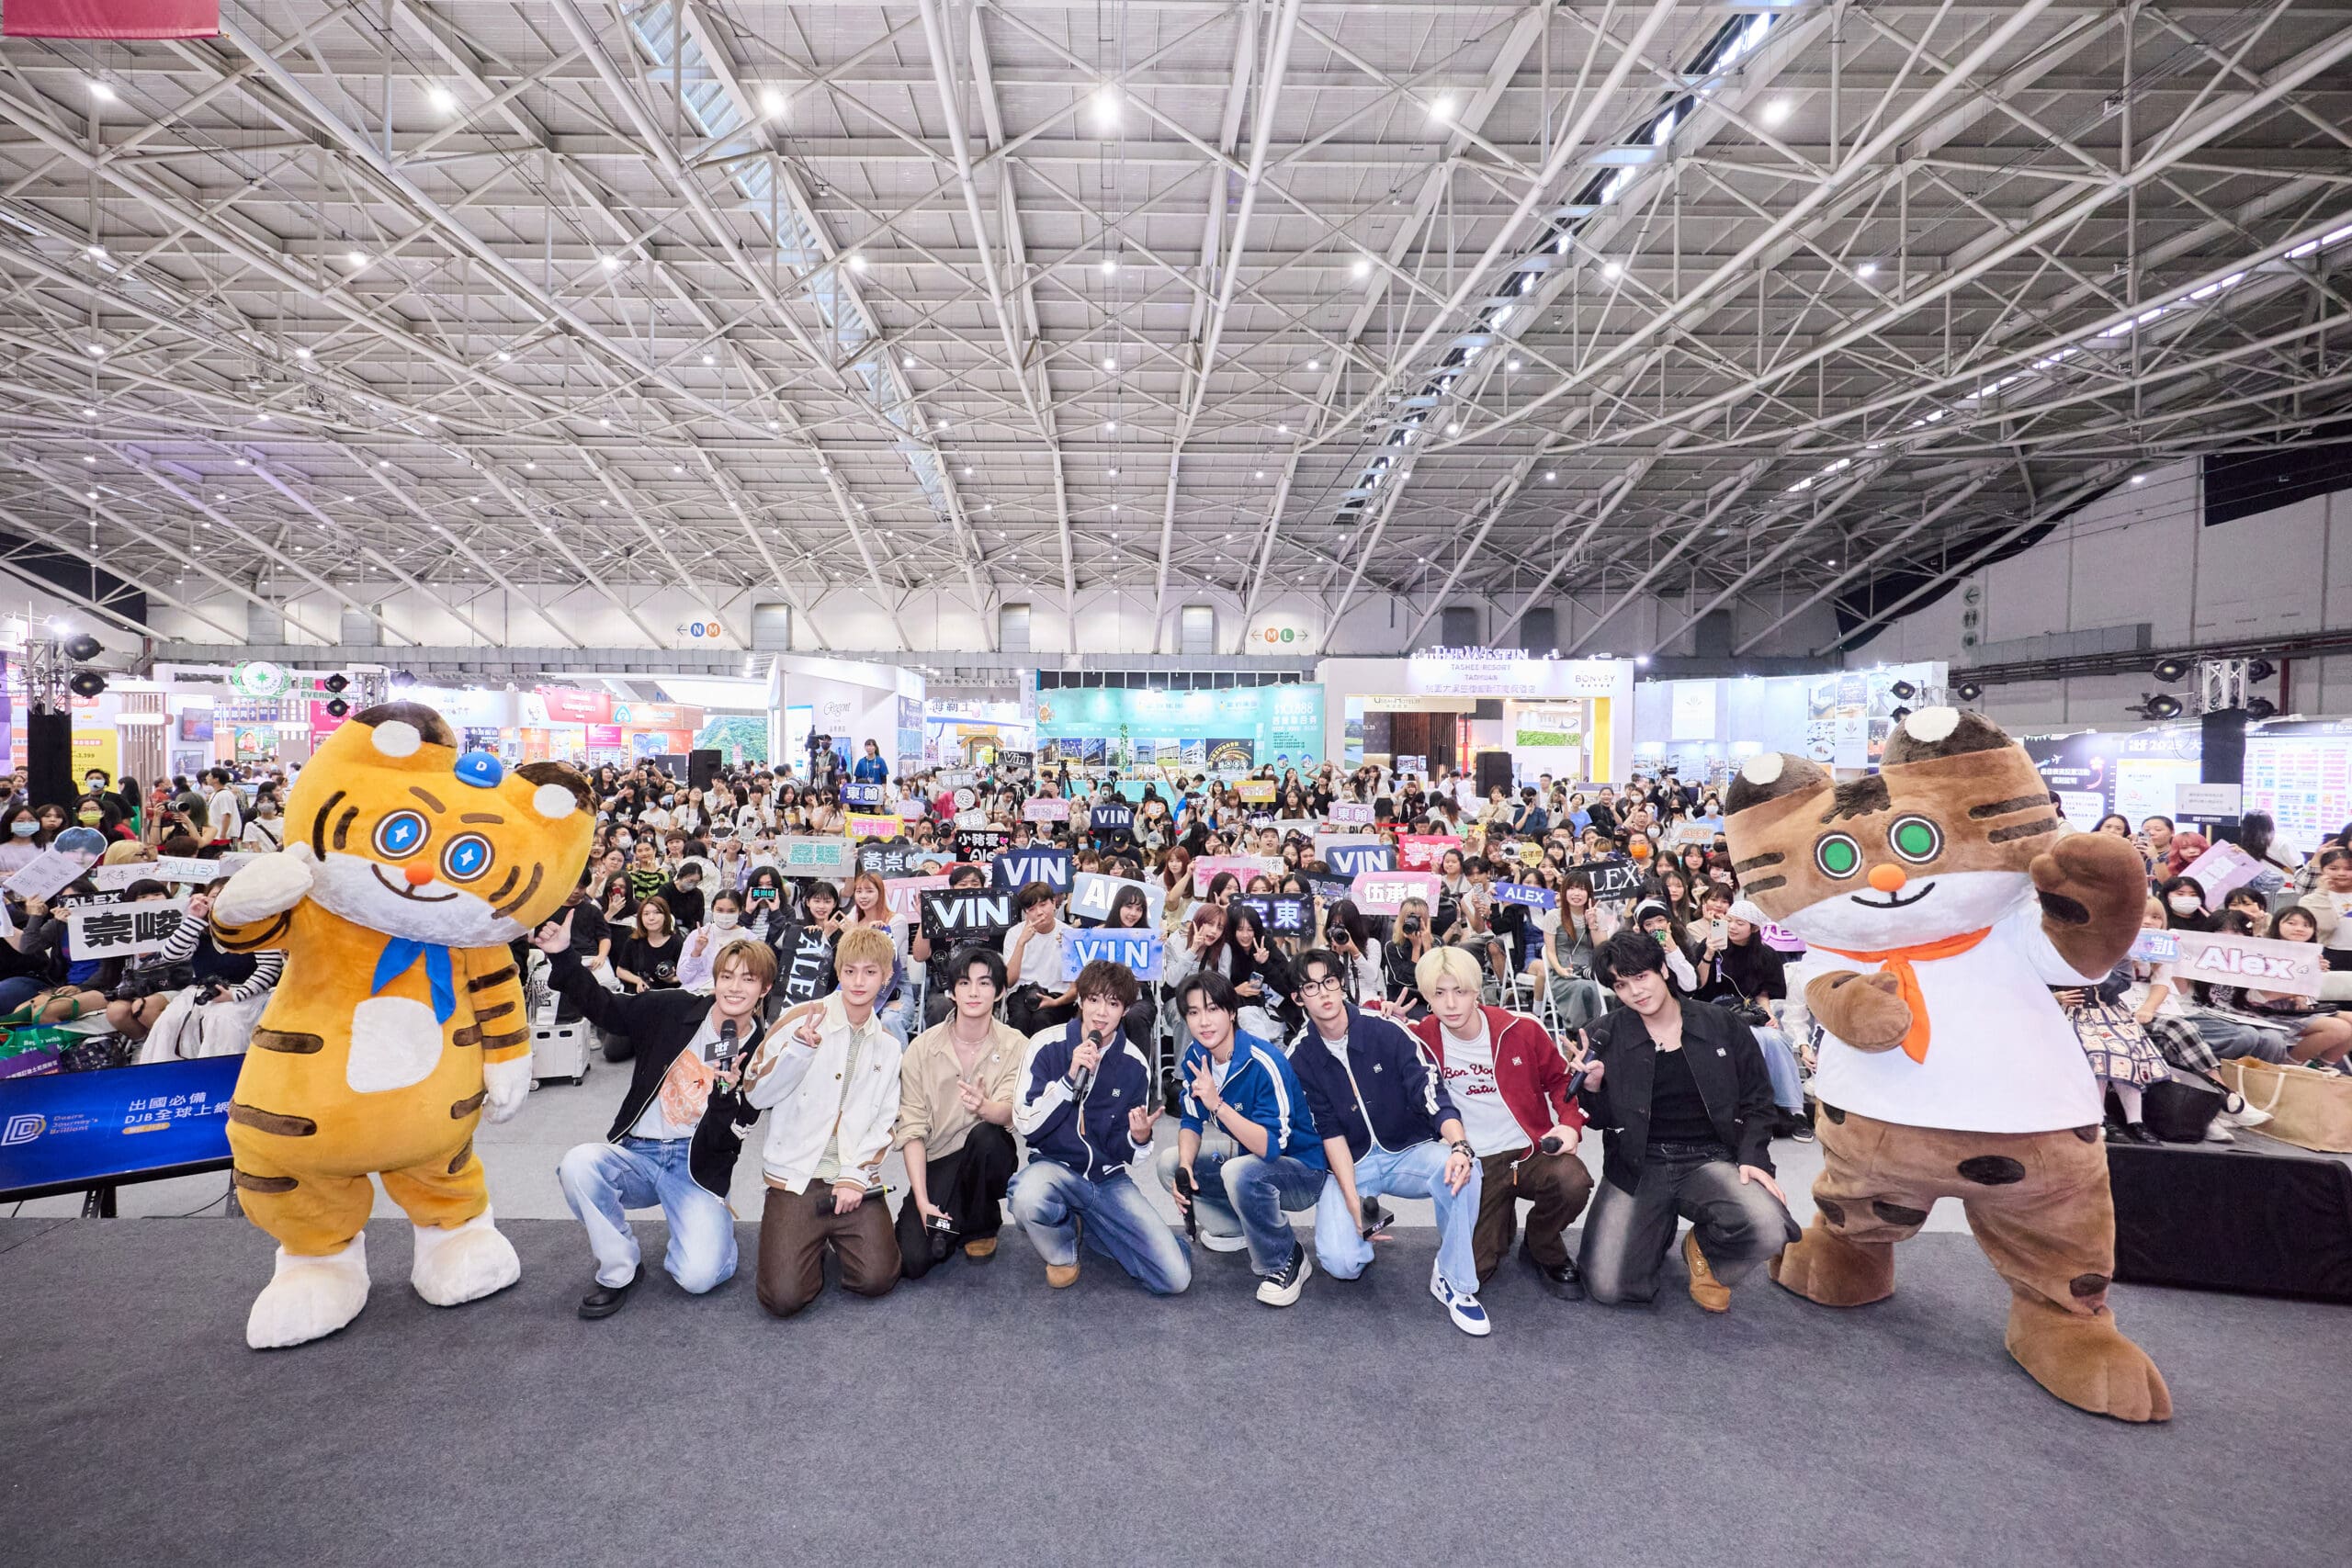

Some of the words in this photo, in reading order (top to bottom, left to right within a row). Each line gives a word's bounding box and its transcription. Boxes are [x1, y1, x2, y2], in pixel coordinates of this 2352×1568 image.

[693, 625, 703, 635] N
[707, 625, 718, 635] M
[1266, 630, 1277, 640] M
[475, 761, 488, 772] D
[1003, 750, 1027, 766] Vin
[1096, 808, 1130, 824] VIN
[969, 848, 996, 862] Ale
[1333, 851, 1389, 874] VIN
[1002, 857, 1066, 886] VIN
[1589, 865, 1641, 893] LEX
[66, 892, 121, 908] ALEX
[1504, 886, 1545, 904] ALEX
[931, 897, 1010, 929] VIN
[1074, 940, 1149, 968] VIN
[2195, 945, 2296, 980] Alex
[782, 931, 825, 1014] ALE
[1443, 1066, 1468, 1079] Bon
[129, 1091, 207, 1112] 出國必備
